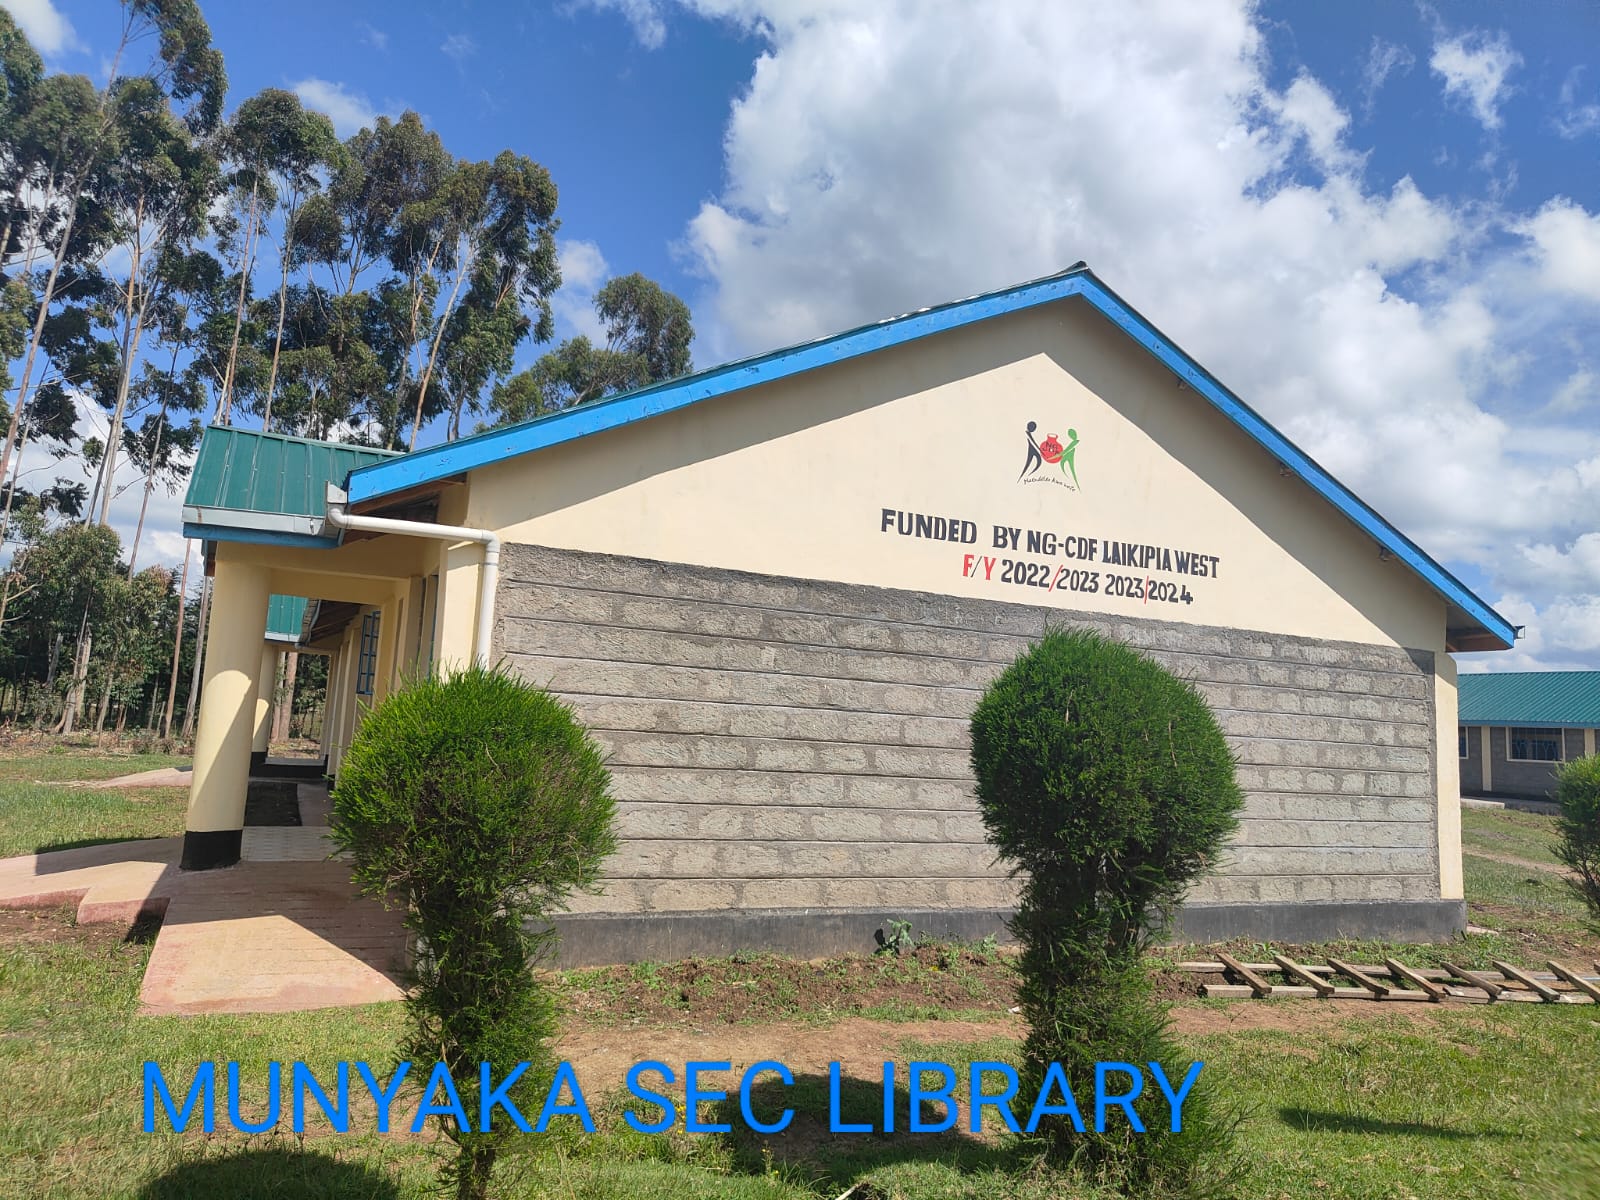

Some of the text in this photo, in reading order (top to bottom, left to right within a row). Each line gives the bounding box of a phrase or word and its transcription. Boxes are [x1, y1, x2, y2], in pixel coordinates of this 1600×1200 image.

[881, 508, 1220, 578] FUNDED BY NG-CDF LAIKIPIA WEST
[963, 554, 1194, 605] F/Y 2022/2023 2023/2024
